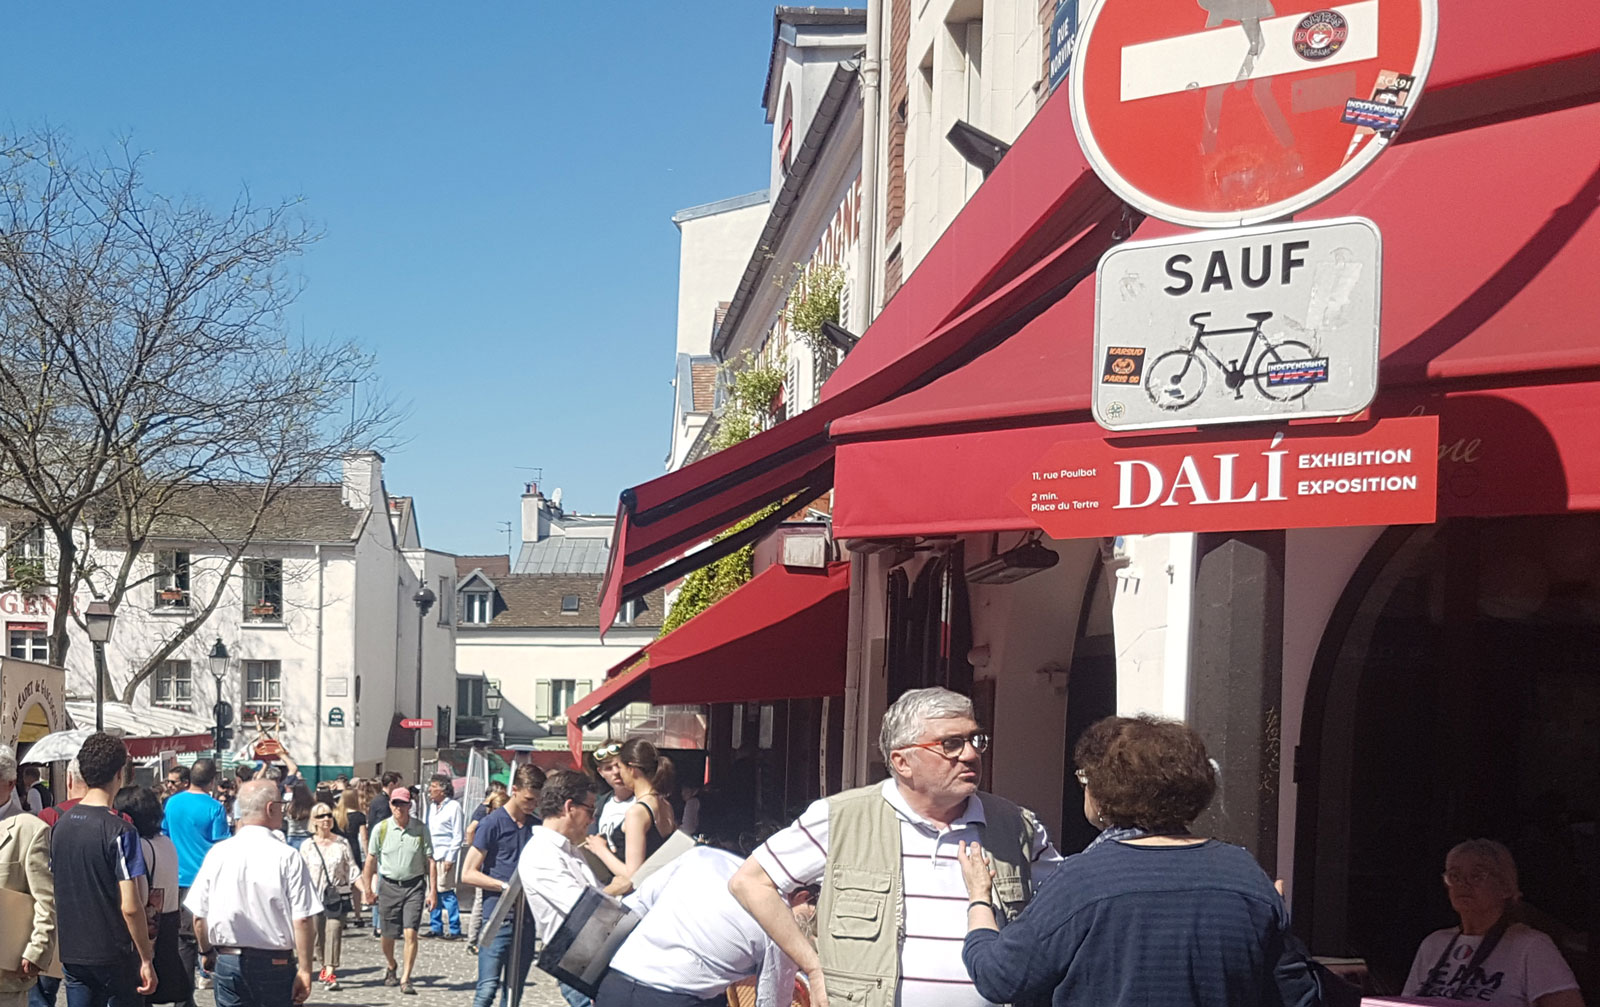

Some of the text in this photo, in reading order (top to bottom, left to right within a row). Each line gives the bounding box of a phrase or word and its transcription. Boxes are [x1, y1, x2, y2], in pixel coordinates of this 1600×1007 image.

[1056, 16, 1069, 47] RUE
[1050, 33, 1075, 79] NORVINS
[1163, 239, 1310, 296] SAUF
[1267, 359, 1327, 371] INDEPENDANTS
[1298, 448, 1412, 470] EXHIBITION
[1043, 472, 1058, 480] rue
[1060, 468, 1097, 479] Poulbot
[1112, 432, 1289, 510] DALÍ
[1297, 475, 1417, 496] EXPOSITION
[1031, 492, 1059, 501] 2 min.
[1031, 501, 1099, 512] Place du Tertre
